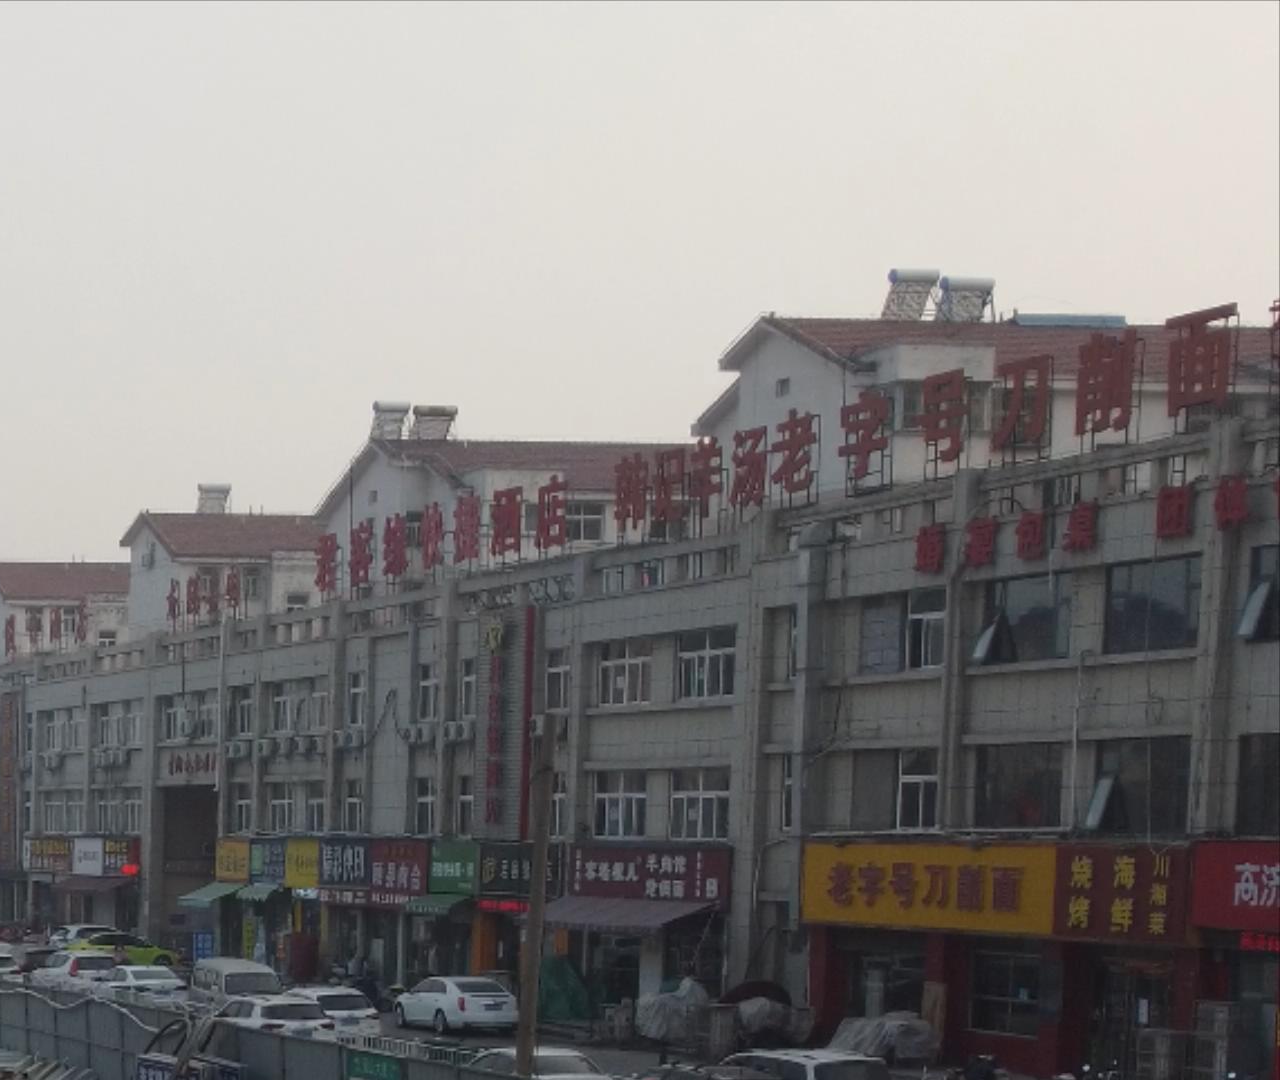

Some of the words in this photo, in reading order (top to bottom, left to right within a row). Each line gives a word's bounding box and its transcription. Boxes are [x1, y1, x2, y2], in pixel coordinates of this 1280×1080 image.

[615, 300, 1280, 530] 韩记羊汤老字号刀削面
[827, 861, 1026, 914] 老字号刀削面
[1069, 855, 1095, 929] 烧烤
[1111, 855, 1136, 932] 海鲜
